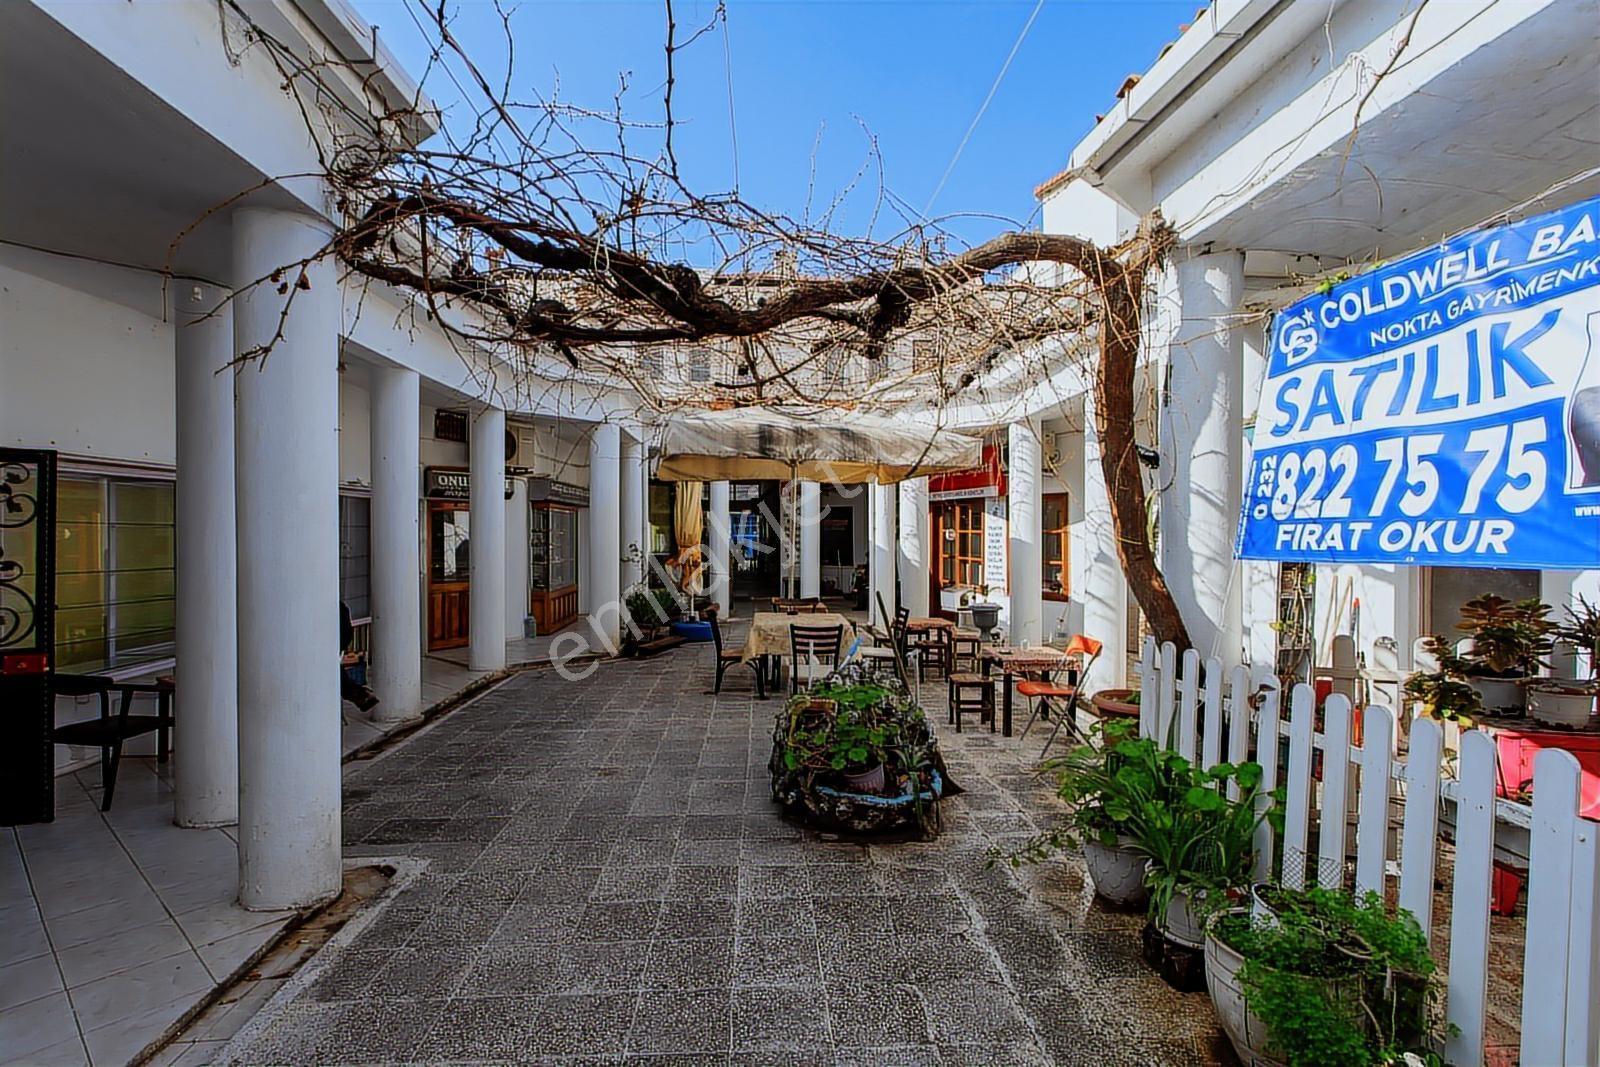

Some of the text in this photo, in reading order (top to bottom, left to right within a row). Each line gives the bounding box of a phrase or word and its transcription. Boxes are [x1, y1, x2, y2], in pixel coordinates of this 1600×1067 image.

[1320, 240, 1510, 329] COLDWELL
[1527, 213, 1600, 261] BA
[1270, 308, 1564, 437] SATILIK
[1370, 312, 1443, 347] NOKTA
[1271, 416, 1548, 521] 822 75 75
[1275, 519, 1515, 555] FIRAT OKUR
